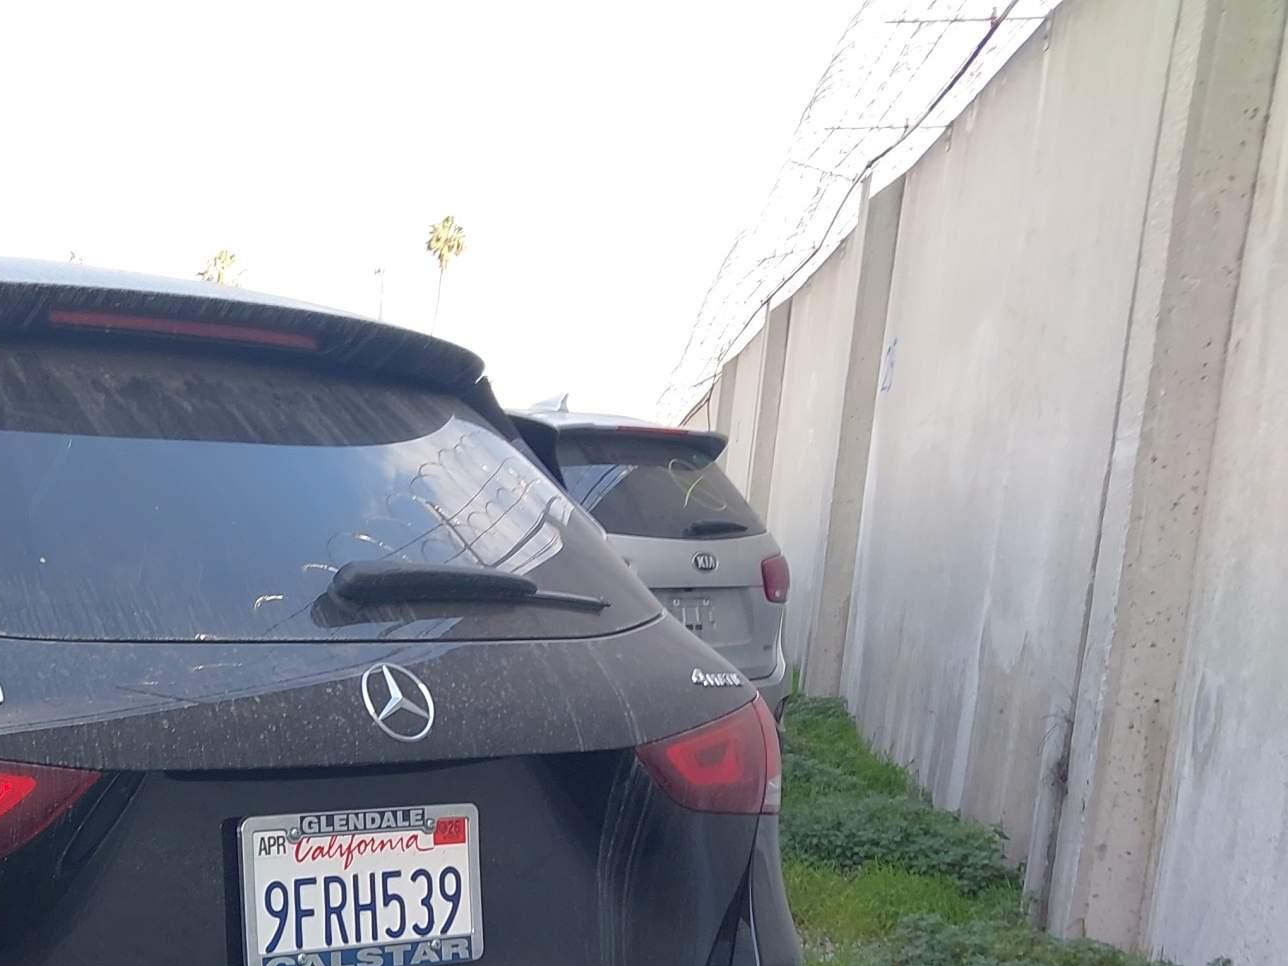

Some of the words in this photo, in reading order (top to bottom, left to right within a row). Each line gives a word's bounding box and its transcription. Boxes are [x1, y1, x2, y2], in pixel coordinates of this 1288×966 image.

[696, 555, 716, 569] KIA
[302, 809, 424, 834] GLENDALE
[258, 836, 286, 857] APR
[295, 832, 434, 870] California
[264, 866, 462, 954] 9FRH539
